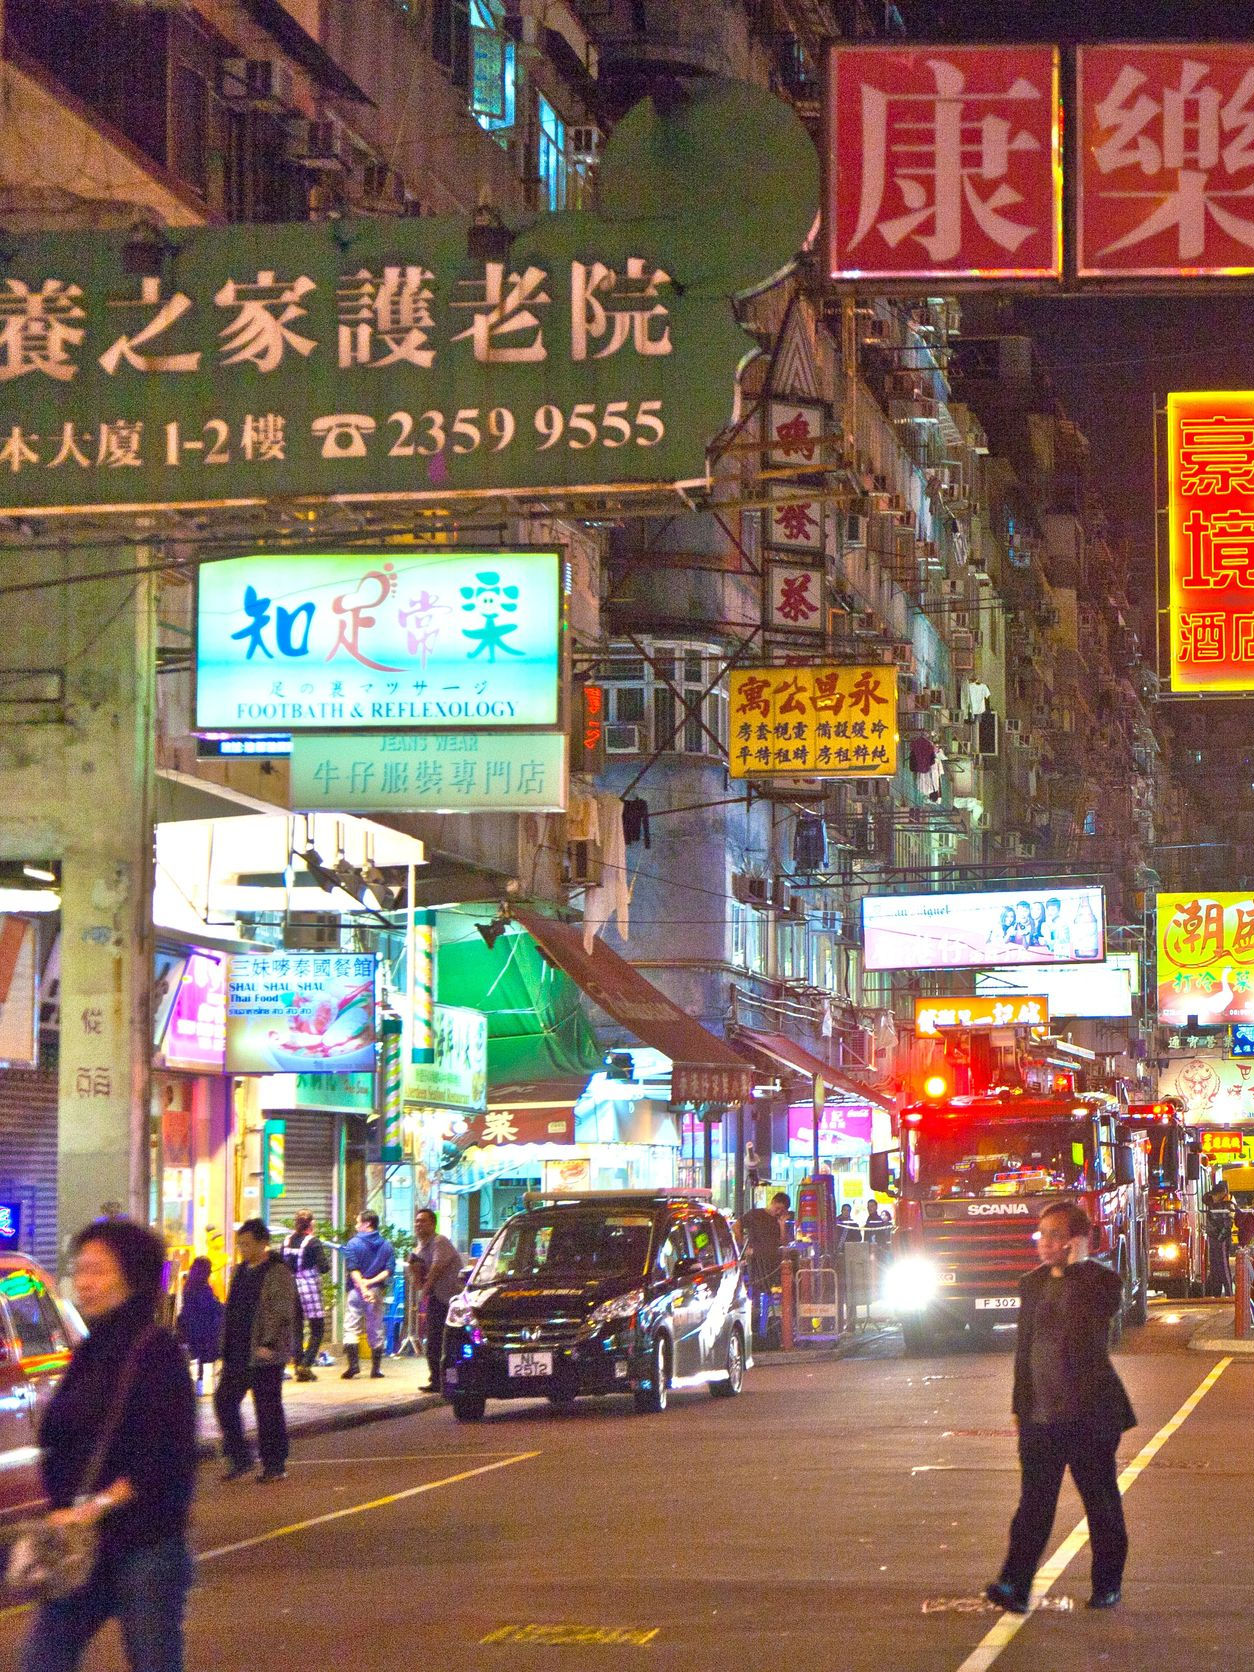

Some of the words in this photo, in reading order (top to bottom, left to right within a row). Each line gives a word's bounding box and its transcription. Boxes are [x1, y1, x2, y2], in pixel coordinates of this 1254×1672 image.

[387, 407, 516, 457] 2359
[535, 401, 667, 449] 9555
[237, 703, 344, 720] FOOTBATH
[350, 704, 363, 718] &
[372, 701, 517, 718] REFLEXOLOGY
[379, 735, 428, 752] JEANS
[435, 734, 478, 751] WEAR
[313, 760, 545, 796] 牛仔服裝專門店
[254, 993, 279, 1003] Food
[967, 1204, 1029, 1215] SCANIA
[984, 1299, 990, 1307] F
[995, 1298, 1016, 1307] 302
